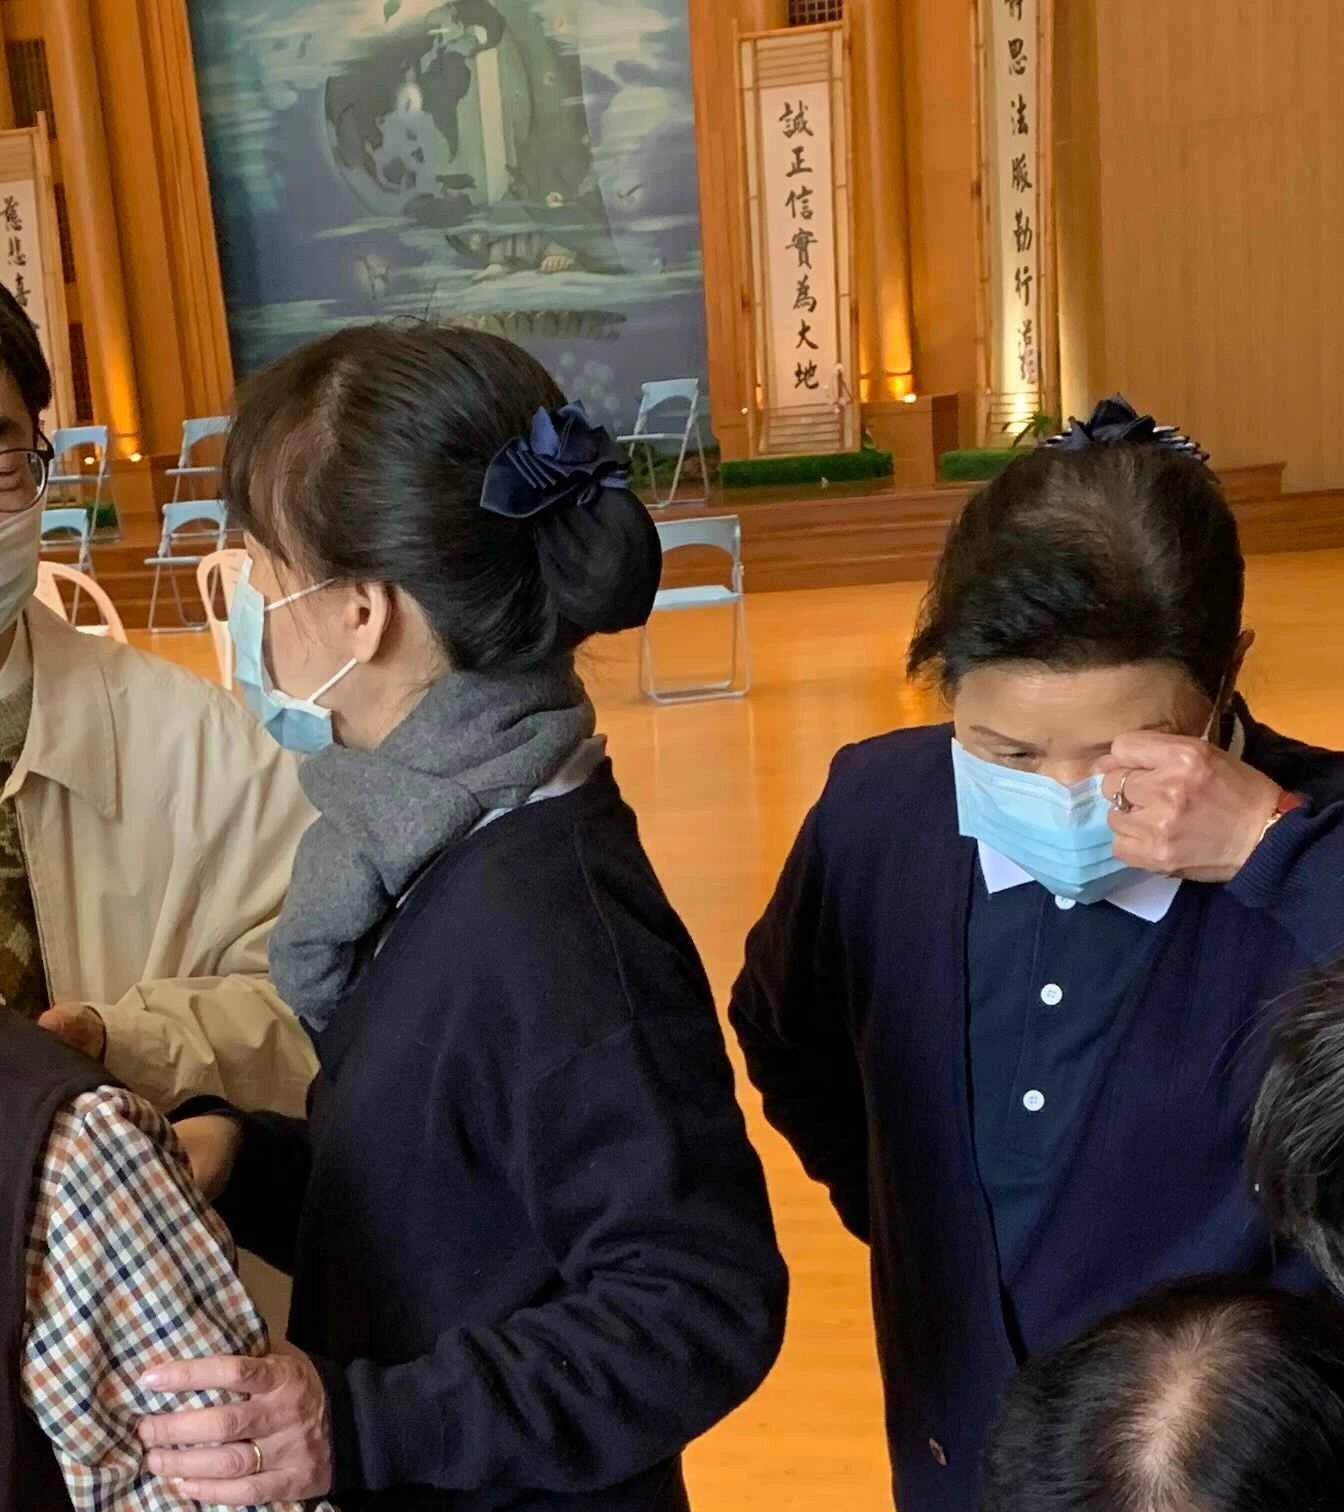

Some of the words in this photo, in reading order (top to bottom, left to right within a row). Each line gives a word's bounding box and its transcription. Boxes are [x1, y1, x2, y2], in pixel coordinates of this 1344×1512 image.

[778, 99, 820, 390] 誠正信實為大地
